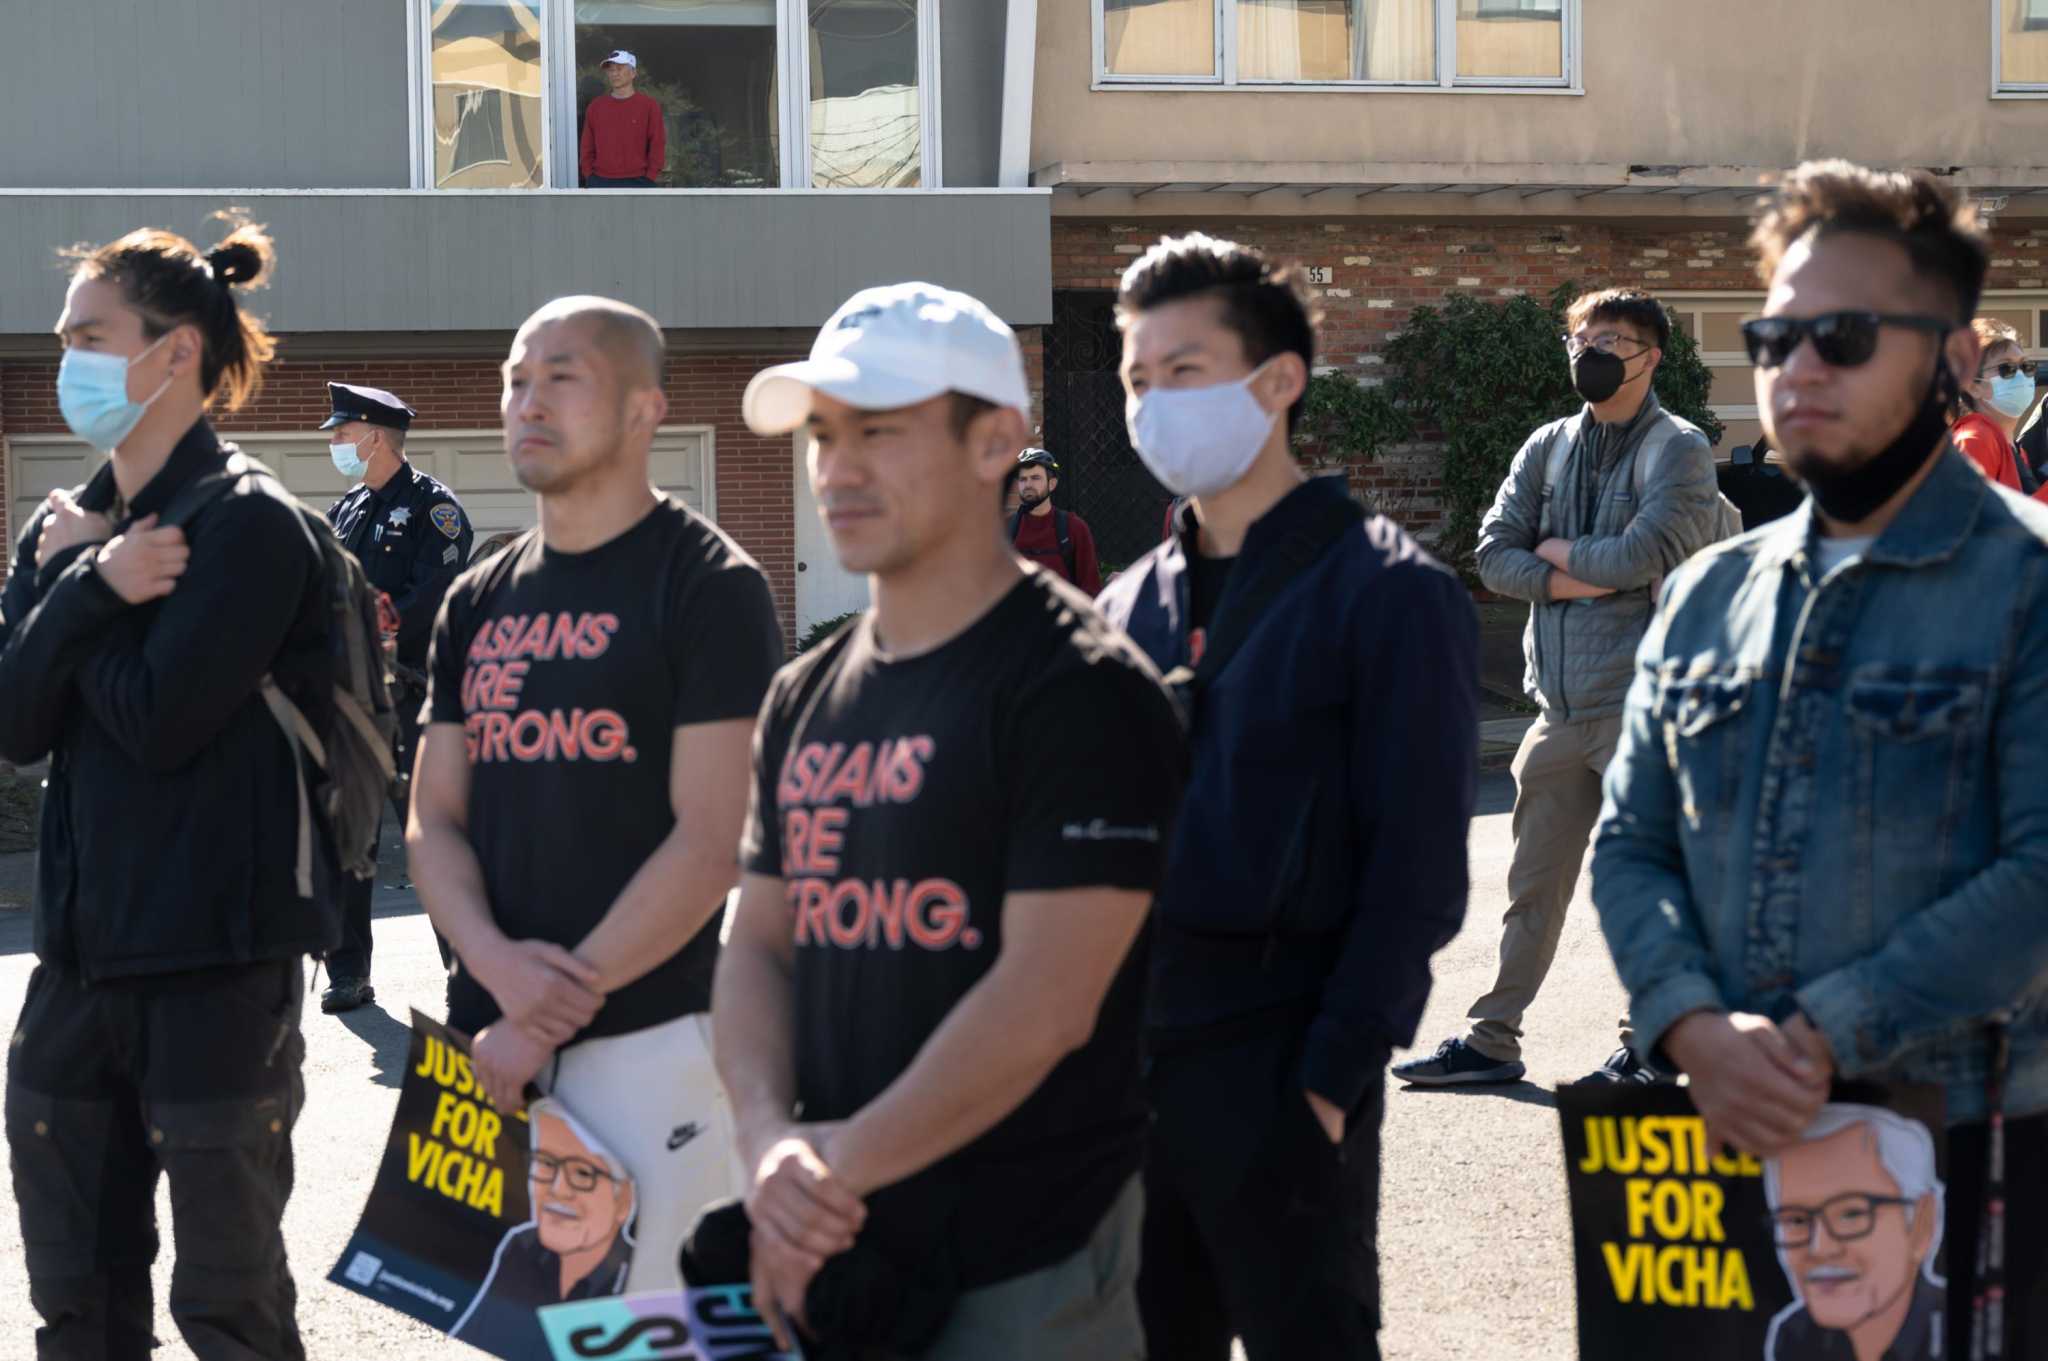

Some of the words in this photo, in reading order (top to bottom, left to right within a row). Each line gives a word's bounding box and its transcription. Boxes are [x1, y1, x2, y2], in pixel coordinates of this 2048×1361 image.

[782, 807, 848, 877] RE
[431, 1091, 501, 1159] FOR
[407, 1131, 504, 1218] VICHA
[1625, 1178, 1727, 1242] FOR
[1601, 1241, 1755, 1311] VICHA
